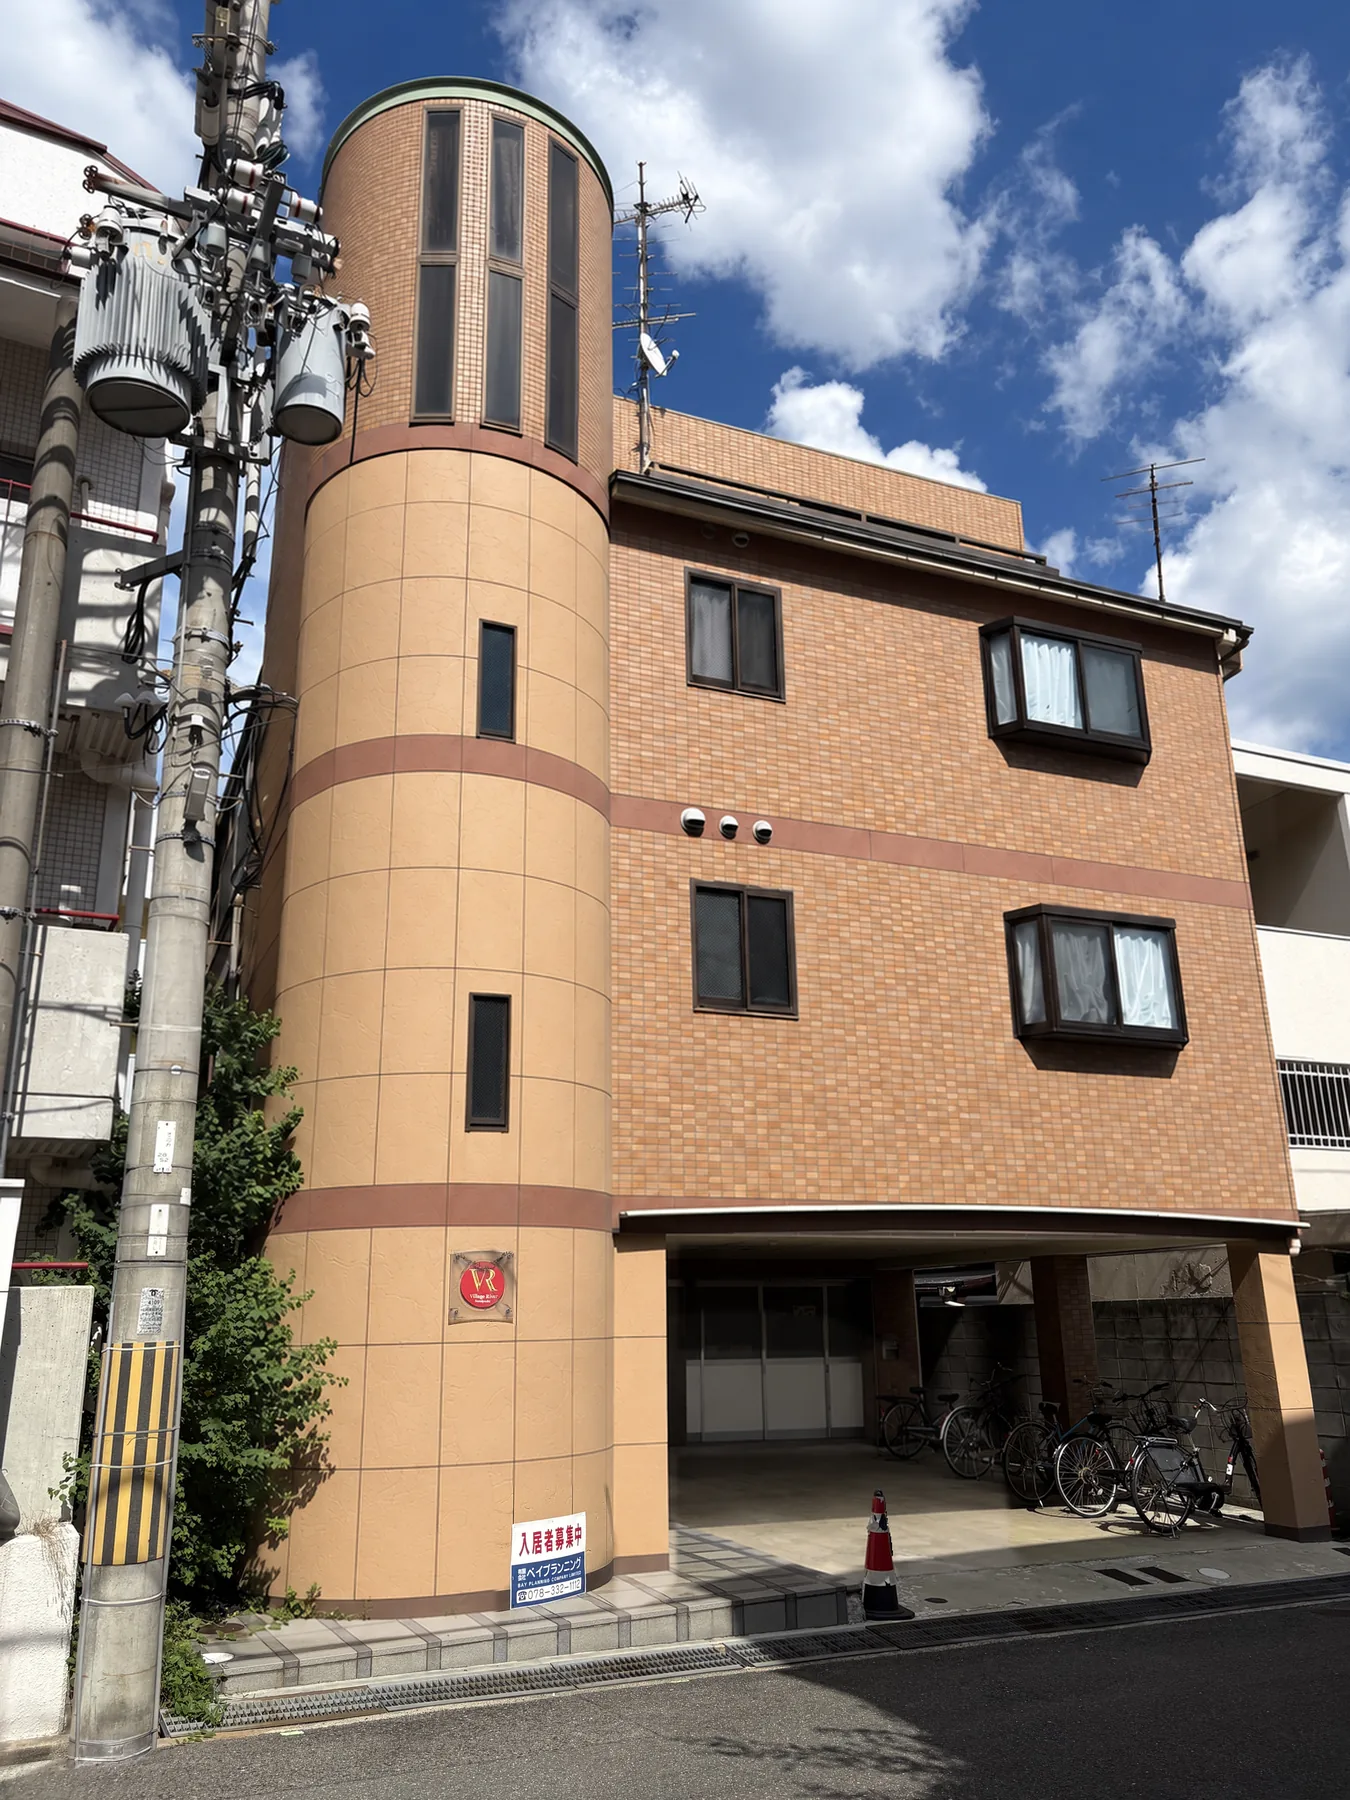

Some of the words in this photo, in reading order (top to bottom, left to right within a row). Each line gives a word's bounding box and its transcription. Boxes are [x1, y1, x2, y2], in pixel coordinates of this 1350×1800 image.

[469, 1268, 498, 1291] VR
[519, 1523, 582, 1556] 入居者募集中
[527, 1579, 580, 1600] 078-332-1112
[528, 1578, 550, 1586] PLANNING
